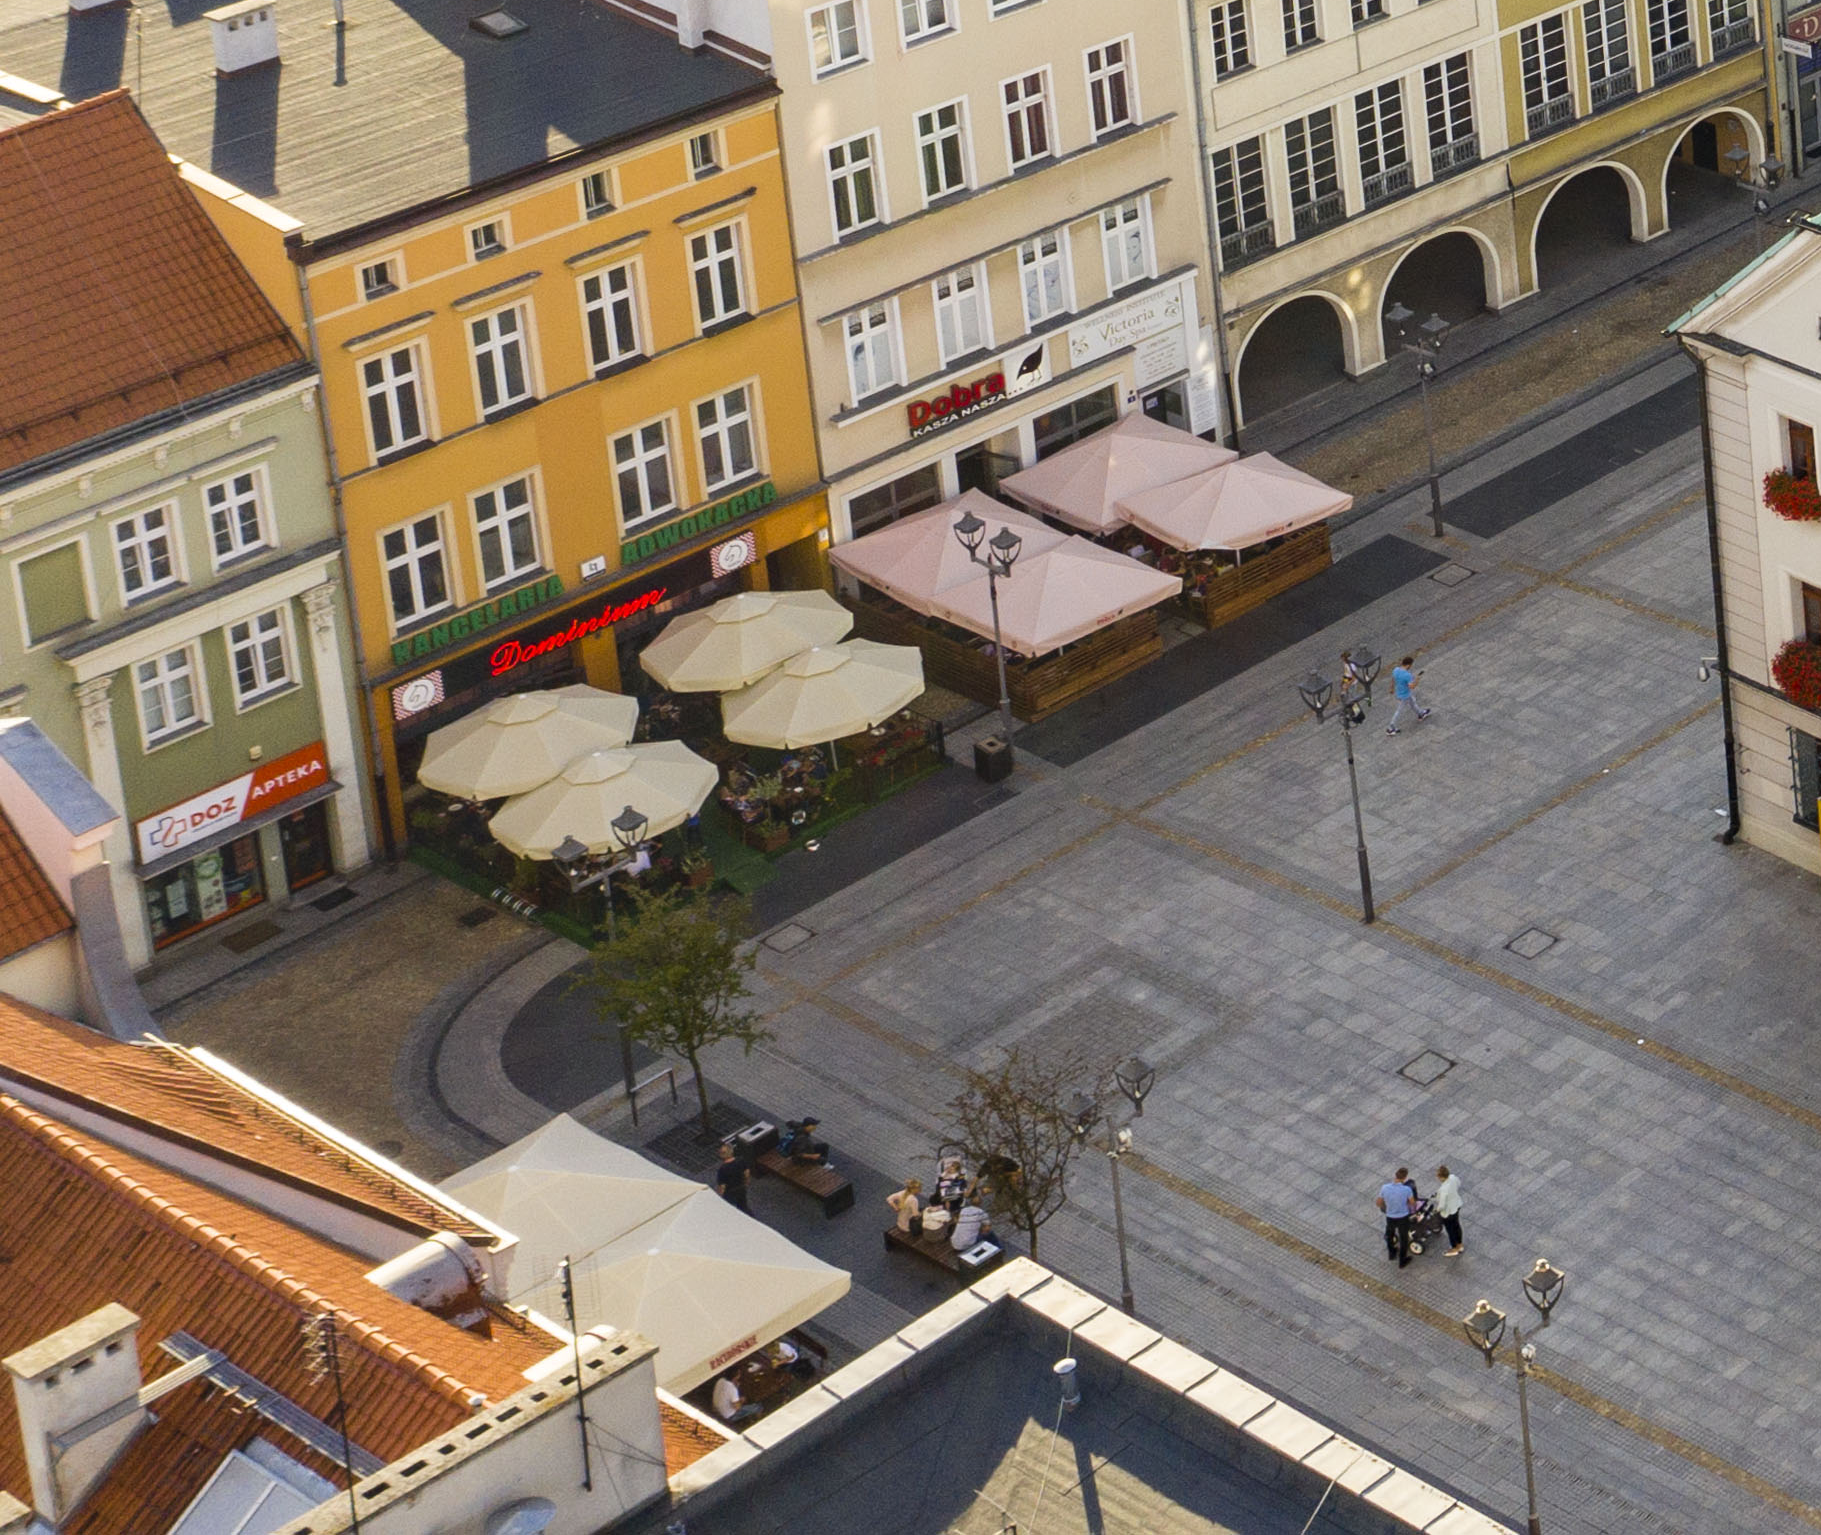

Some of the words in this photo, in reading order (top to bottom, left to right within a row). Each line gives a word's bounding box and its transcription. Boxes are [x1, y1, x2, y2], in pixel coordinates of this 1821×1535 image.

[1099, 309, 1154, 341] Victoria
[906, 371, 1006, 428] Dobra
[913, 413, 958, 438] KASZA
[621, 483, 778, 565] ADWOKACKA
[392, 574, 564, 665] KANCELARIA
[490, 588, 667, 677] Dominium
[190, 796, 237, 827] DOZ
[252, 760, 322, 799] APTEKA
